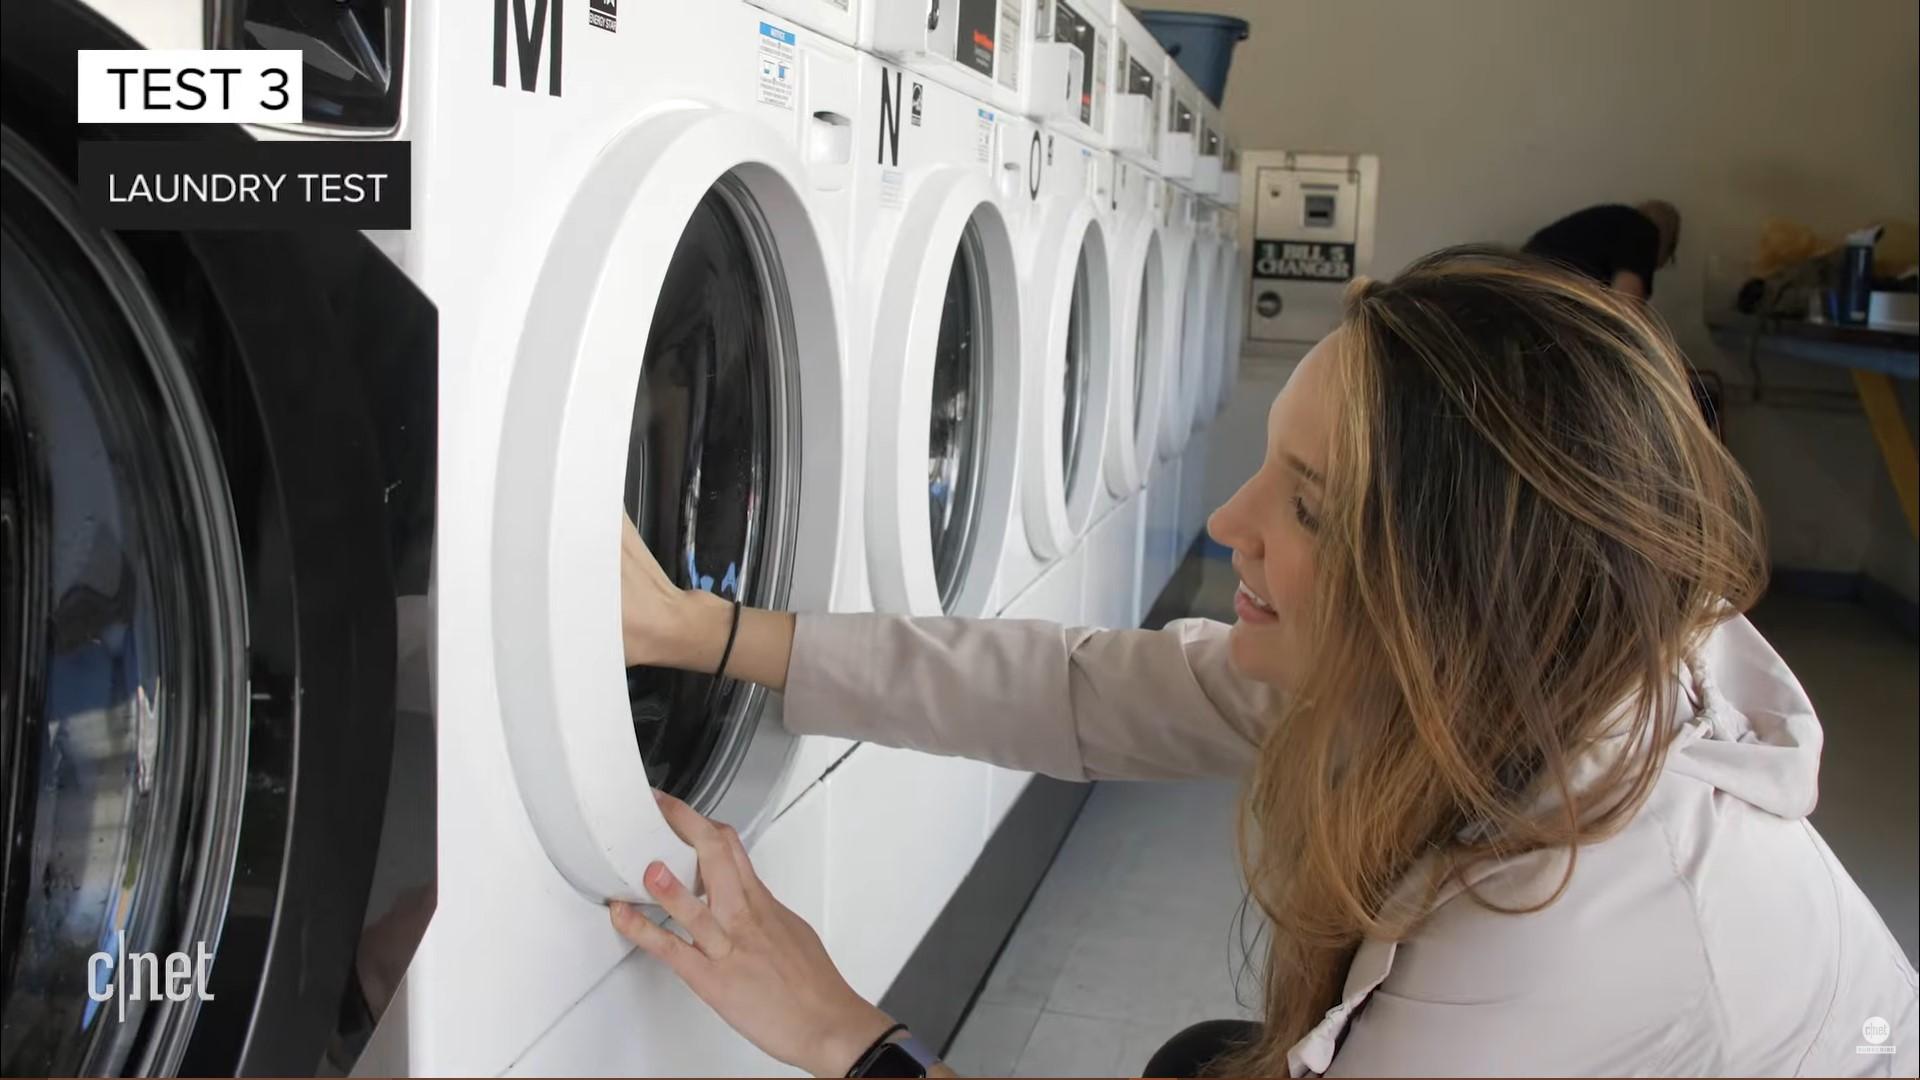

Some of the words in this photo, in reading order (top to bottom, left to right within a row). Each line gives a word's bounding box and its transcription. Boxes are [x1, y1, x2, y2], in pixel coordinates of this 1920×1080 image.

[492, 0, 563, 97] M
[878, 67, 902, 166] N
[1256, 259, 1350, 277] CHANGER
[1283, 243, 1325, 261] BILL
